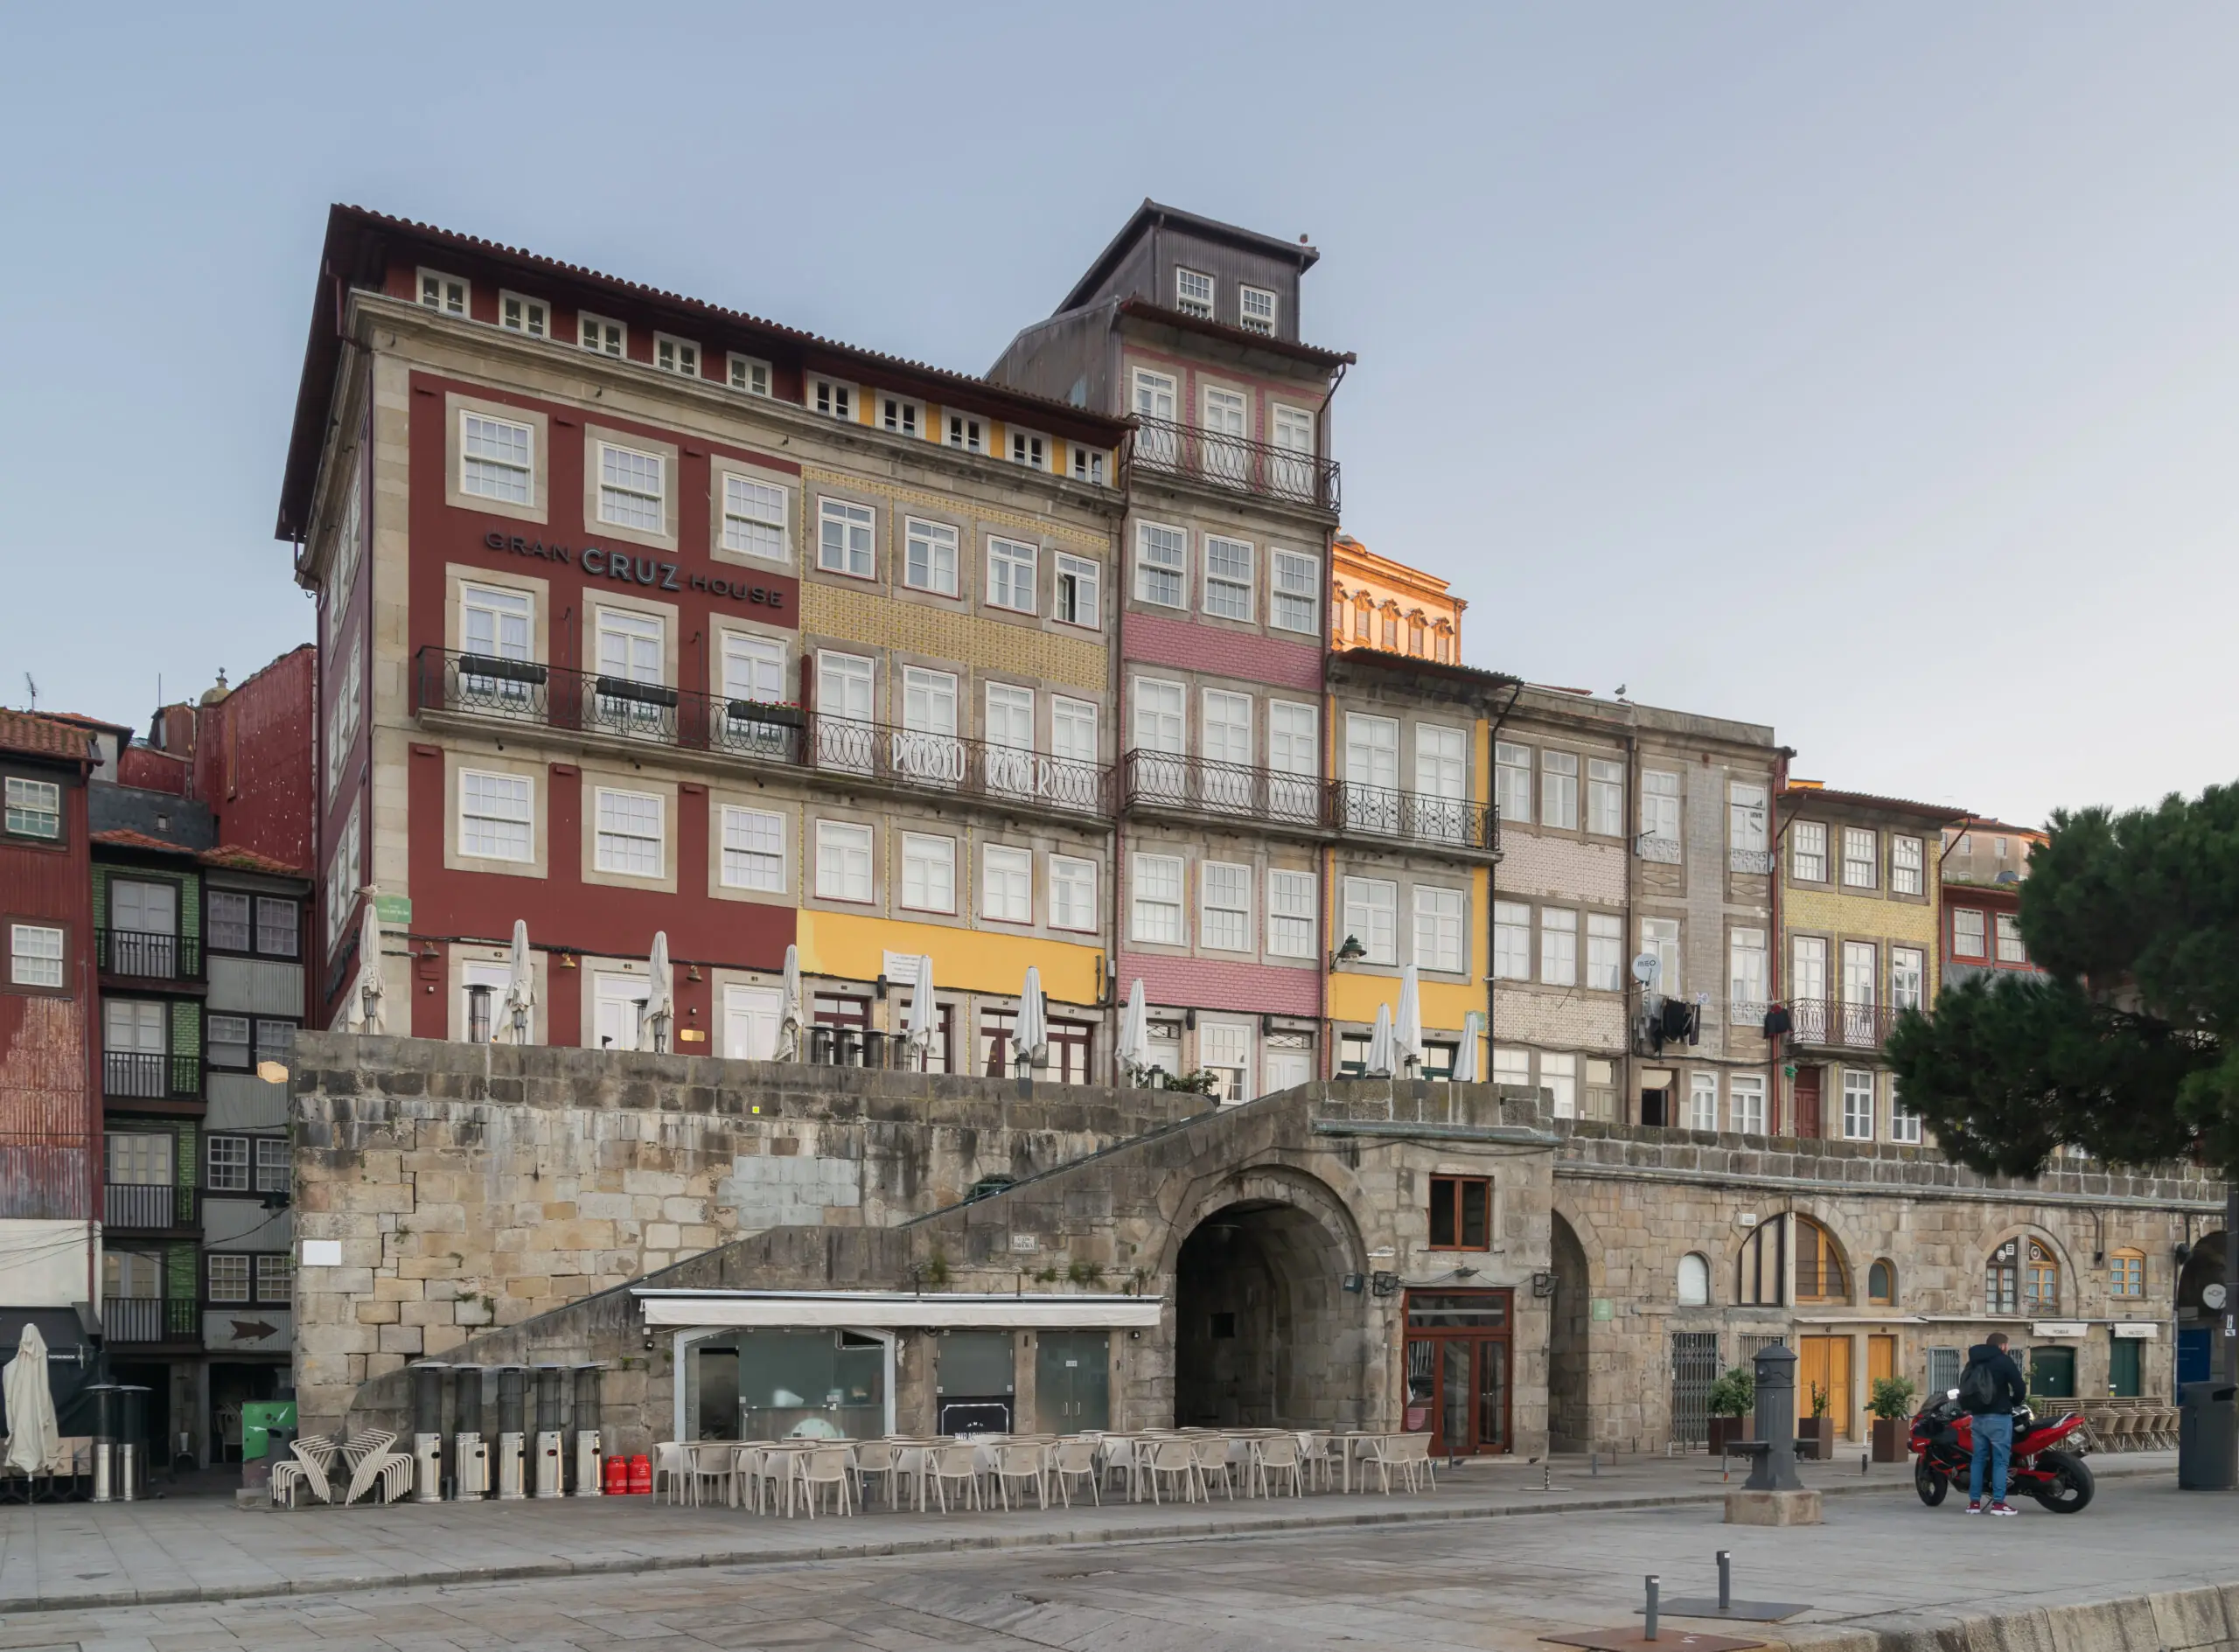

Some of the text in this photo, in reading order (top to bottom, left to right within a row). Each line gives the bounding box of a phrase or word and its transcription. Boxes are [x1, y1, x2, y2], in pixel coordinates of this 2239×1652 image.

[486, 532, 785, 608] GRAN CRUZ HOUSE
